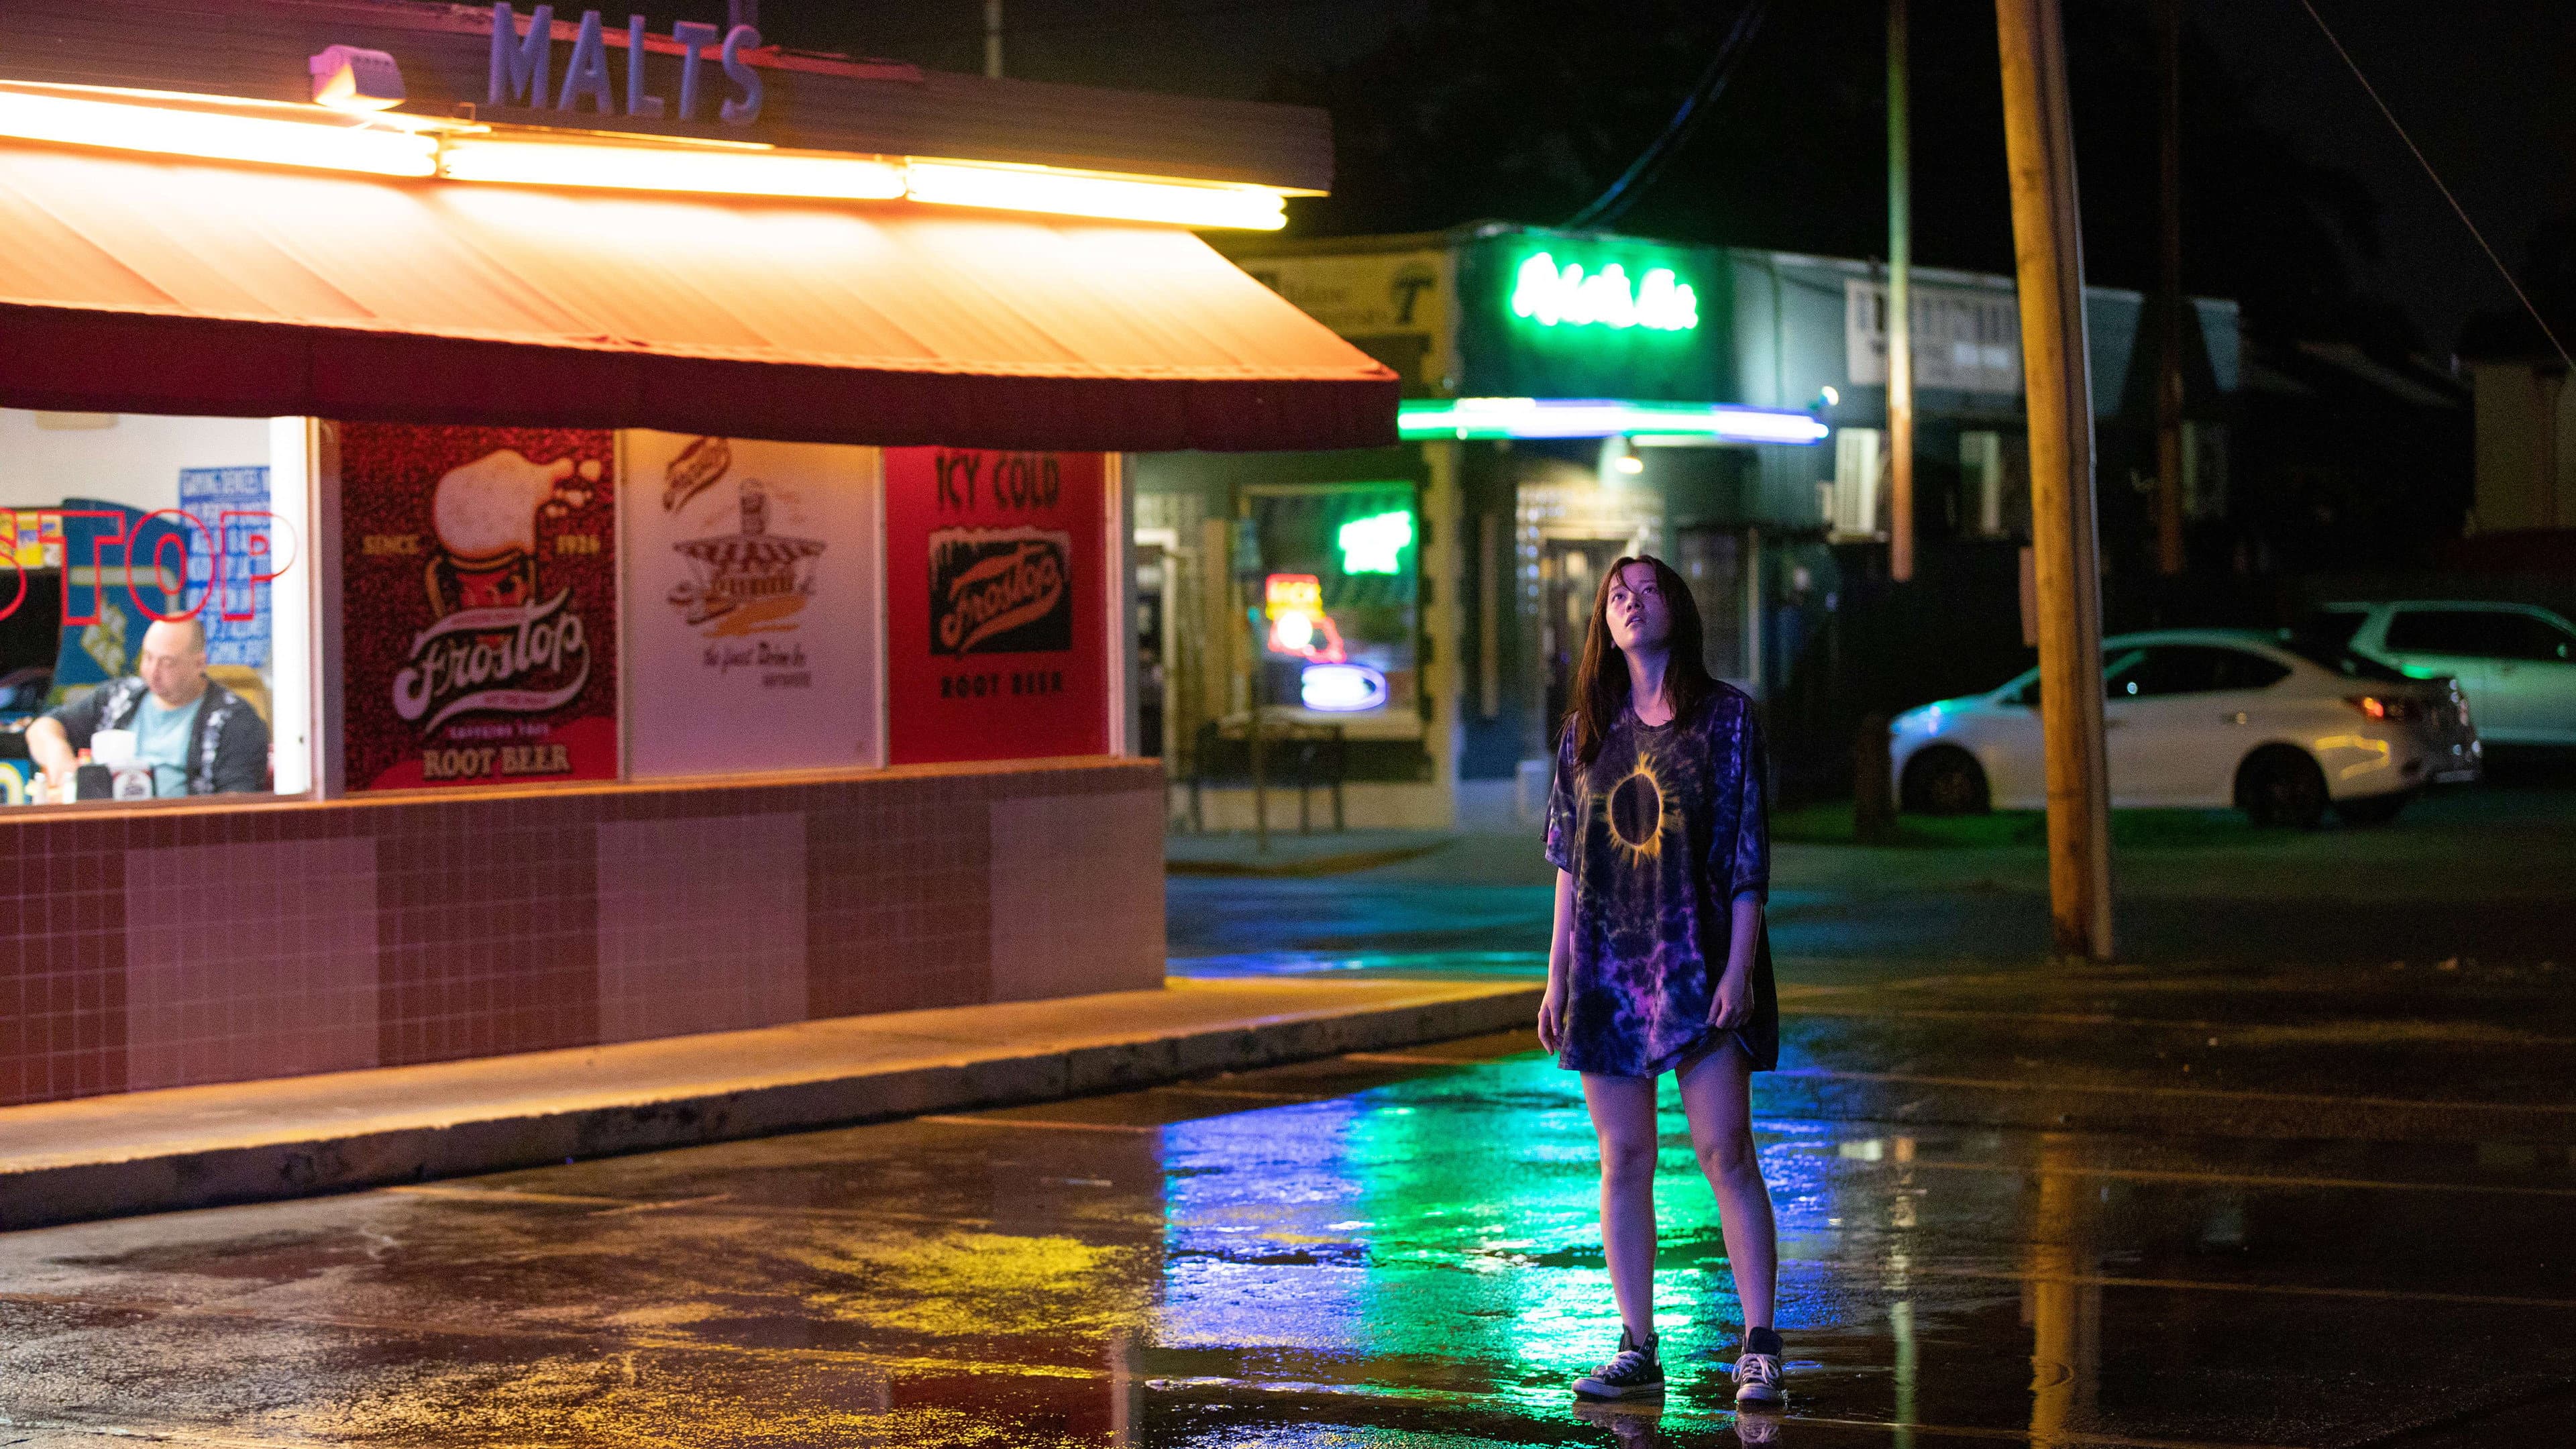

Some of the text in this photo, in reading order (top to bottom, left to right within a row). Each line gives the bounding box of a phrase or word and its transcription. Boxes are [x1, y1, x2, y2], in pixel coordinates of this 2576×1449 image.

[488, 2, 763, 125] MALTS
[936, 455, 1061, 508] ICY COLD
[362, 534, 420, 555] SINCE
[941, 542, 1063, 652] Frostop
[392, 586, 590, 735] Frostop
[941, 669, 1063, 698] ROOT BEER
[423, 745, 572, 780] ROOT BEER
